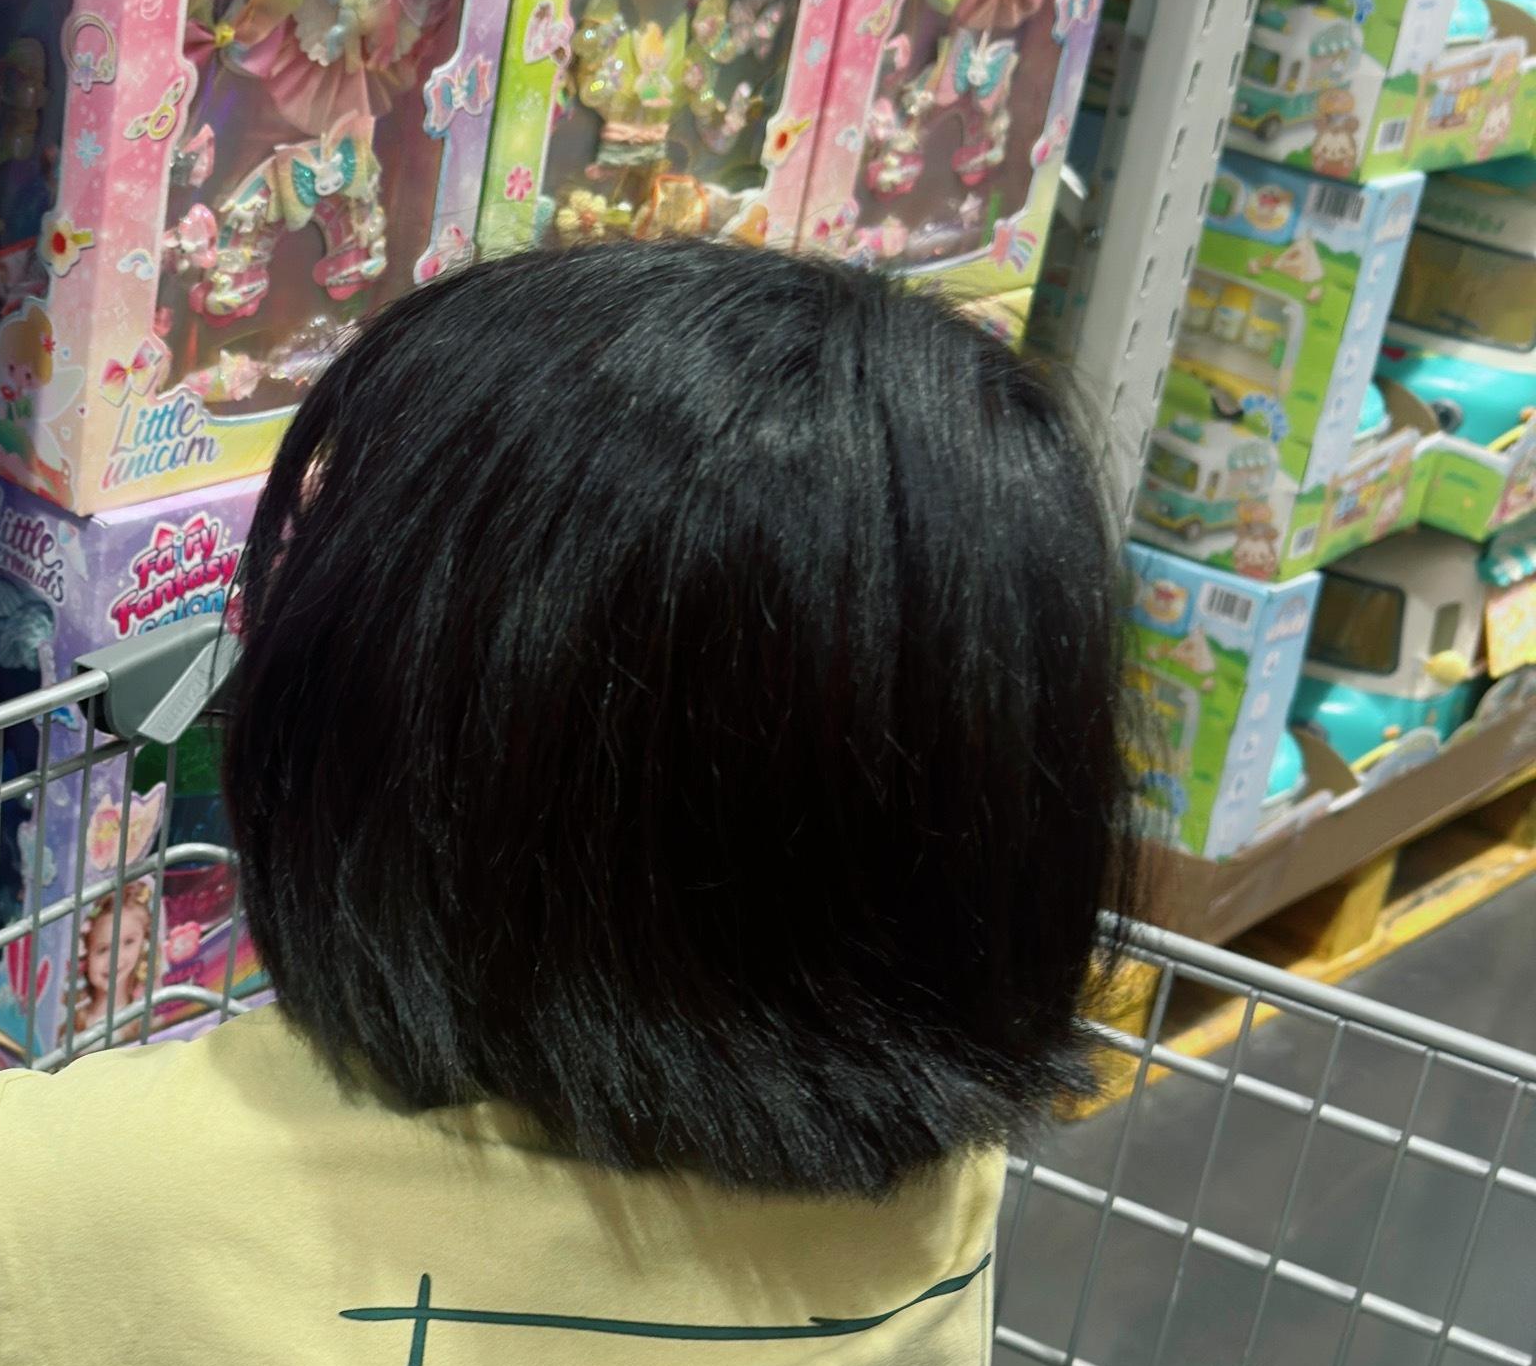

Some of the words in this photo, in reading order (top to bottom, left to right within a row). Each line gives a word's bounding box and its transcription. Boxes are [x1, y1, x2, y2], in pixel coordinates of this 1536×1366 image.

[110, 395, 205, 456] Little
[101, 435, 216, 490] unicorn
[111, 549, 240, 636] Fantasy
